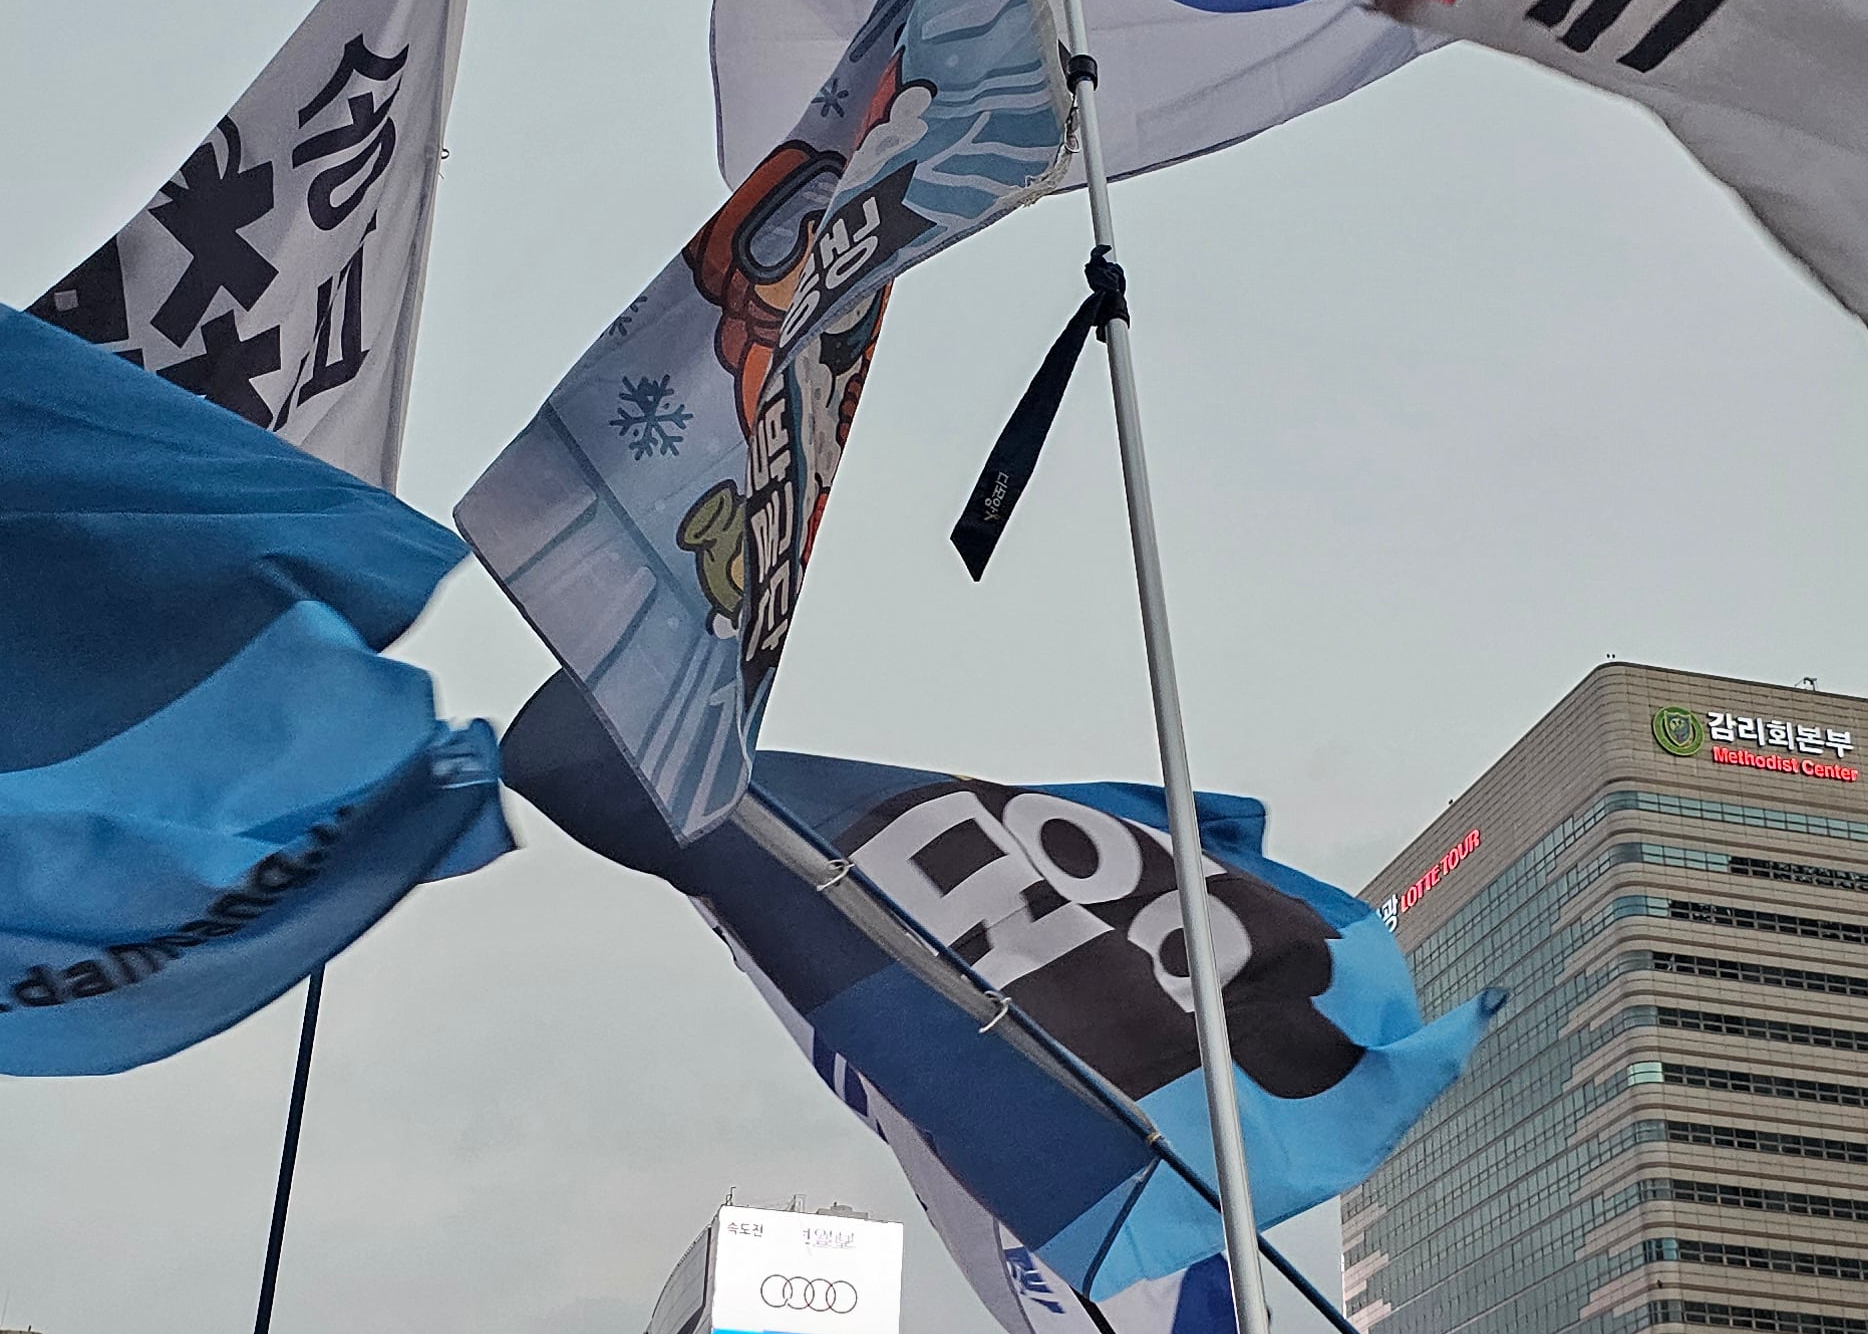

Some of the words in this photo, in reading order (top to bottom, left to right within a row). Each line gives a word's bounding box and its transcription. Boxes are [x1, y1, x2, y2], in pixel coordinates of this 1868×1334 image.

[1707, 711, 1855, 759] 감리회본부
[1713, 745, 1799, 774] Methodist
[1801, 758, 1859, 782] Center
[1400, 864, 1441, 914] LOTTE
[1439, 828, 1481, 876] TOUR
